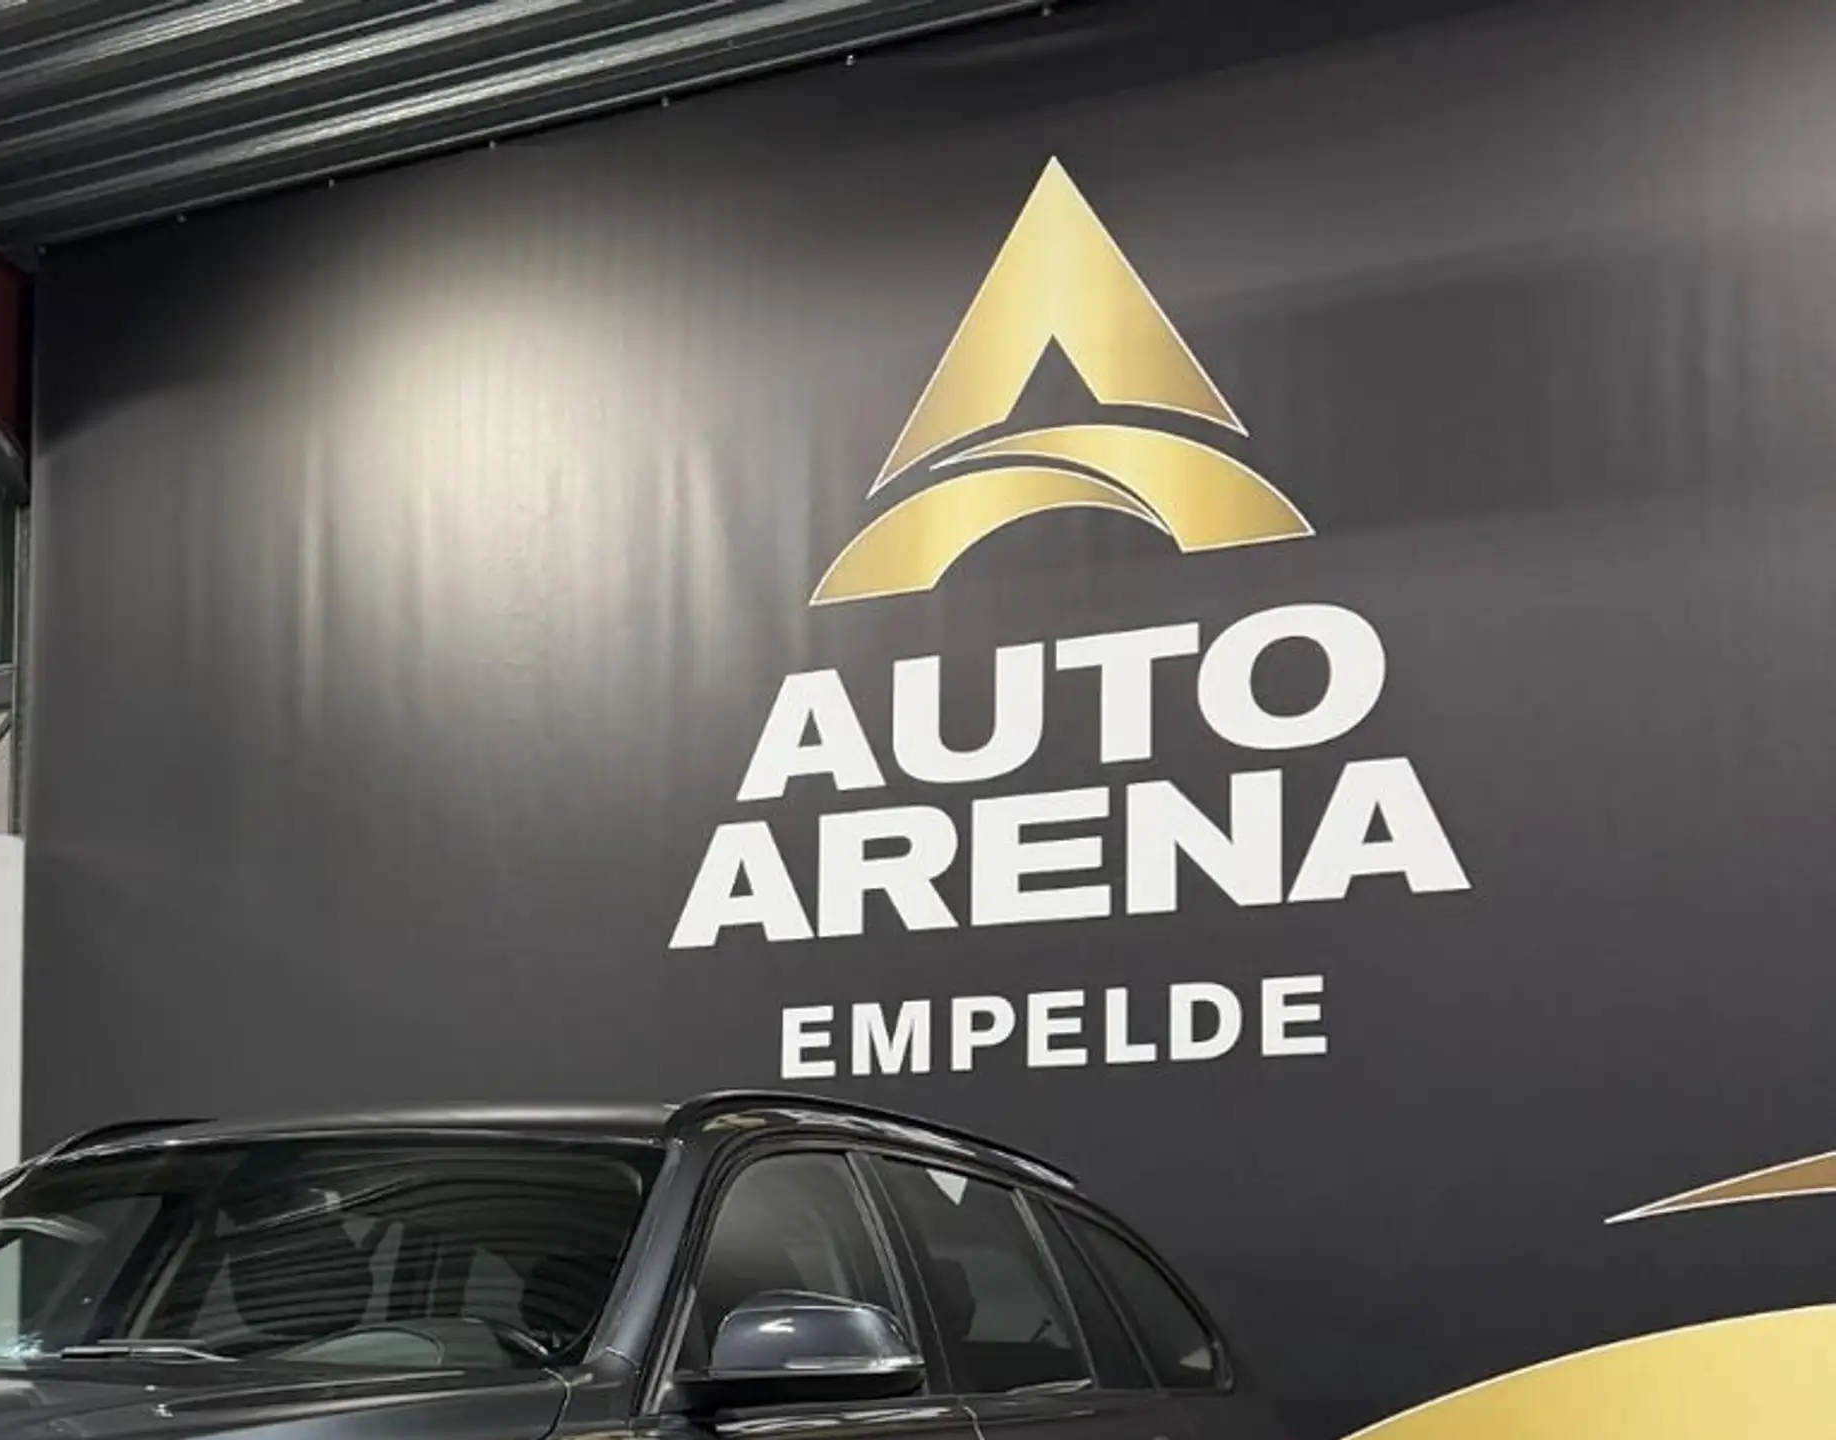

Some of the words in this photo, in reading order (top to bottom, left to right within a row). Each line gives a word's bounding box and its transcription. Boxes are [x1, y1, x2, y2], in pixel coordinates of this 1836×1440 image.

[737, 603, 1386, 800] AUTO
[668, 757, 1471, 949] ARENA
[781, 975, 1328, 1079] EMPELDE
